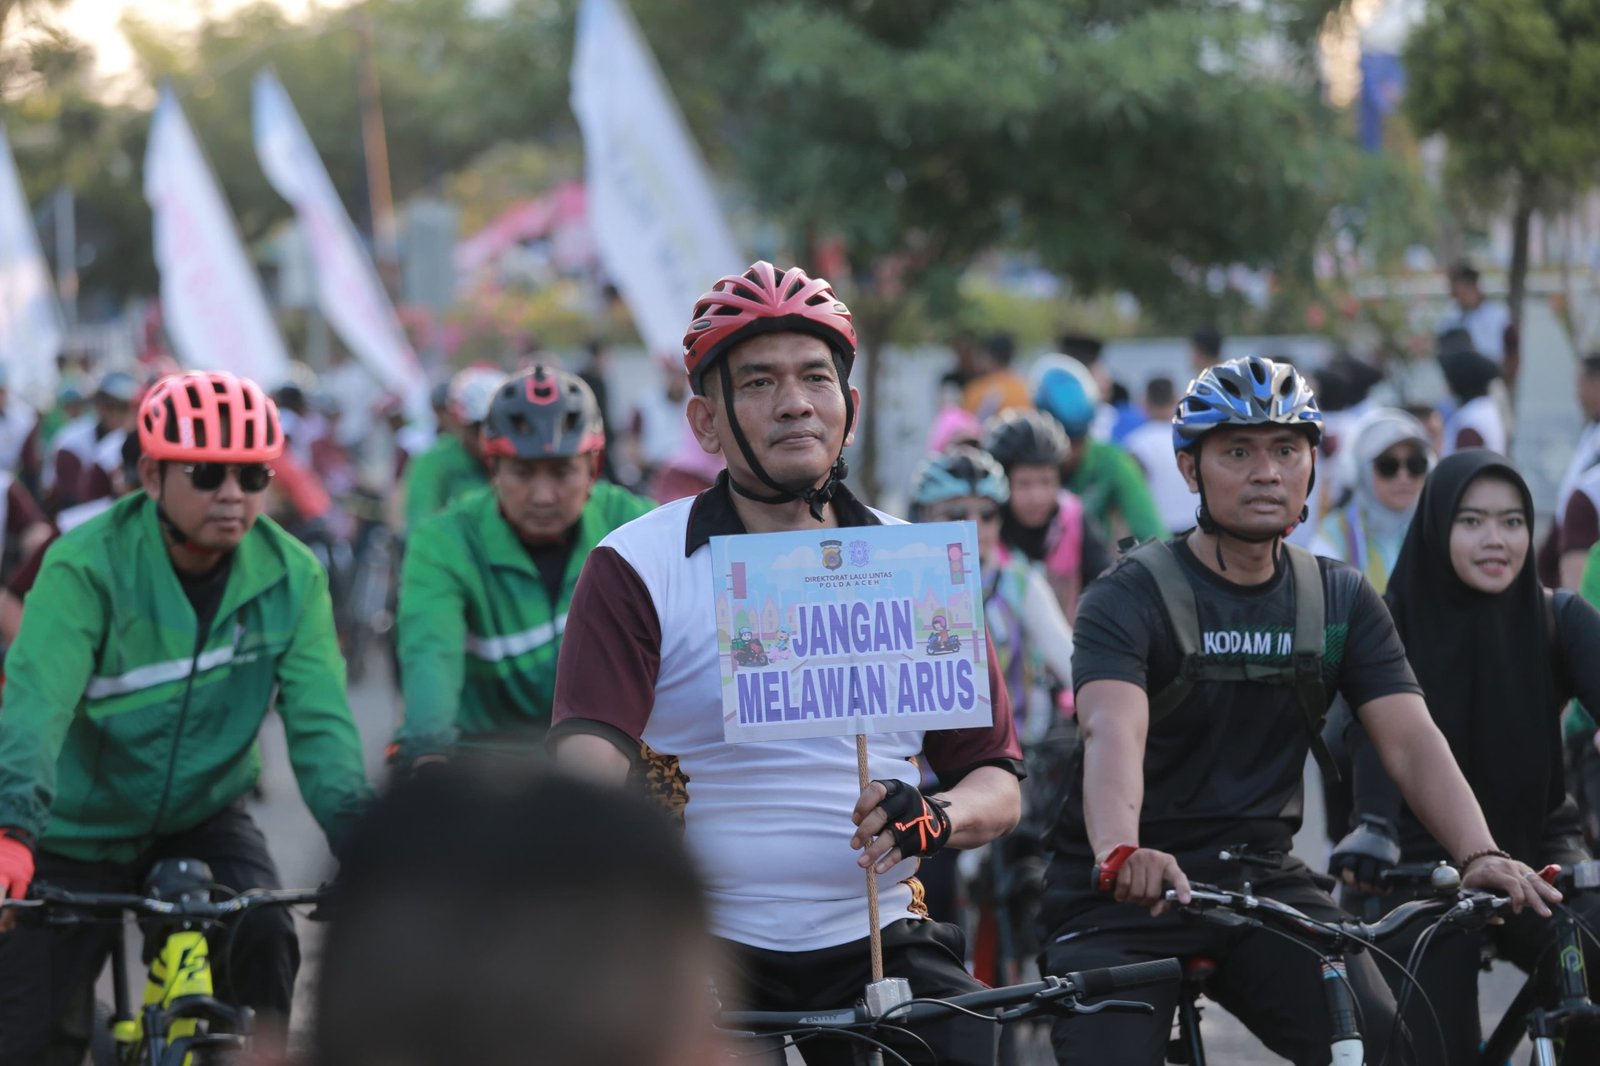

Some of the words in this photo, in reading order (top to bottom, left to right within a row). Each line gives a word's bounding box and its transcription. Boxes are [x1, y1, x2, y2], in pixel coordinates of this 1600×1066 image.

[804, 574, 848, 583] DIREKTORAT
[869, 571, 893, 579] LINTAS
[819, 581, 852, 589] POLDA
[854, 579, 880, 587] ACEH
[792, 600, 914, 658] JANGAN
[1203, 630, 1272, 655] KODAM
[738, 664, 888, 724] MELAWAN
[897, 659, 975, 712] ARUS
